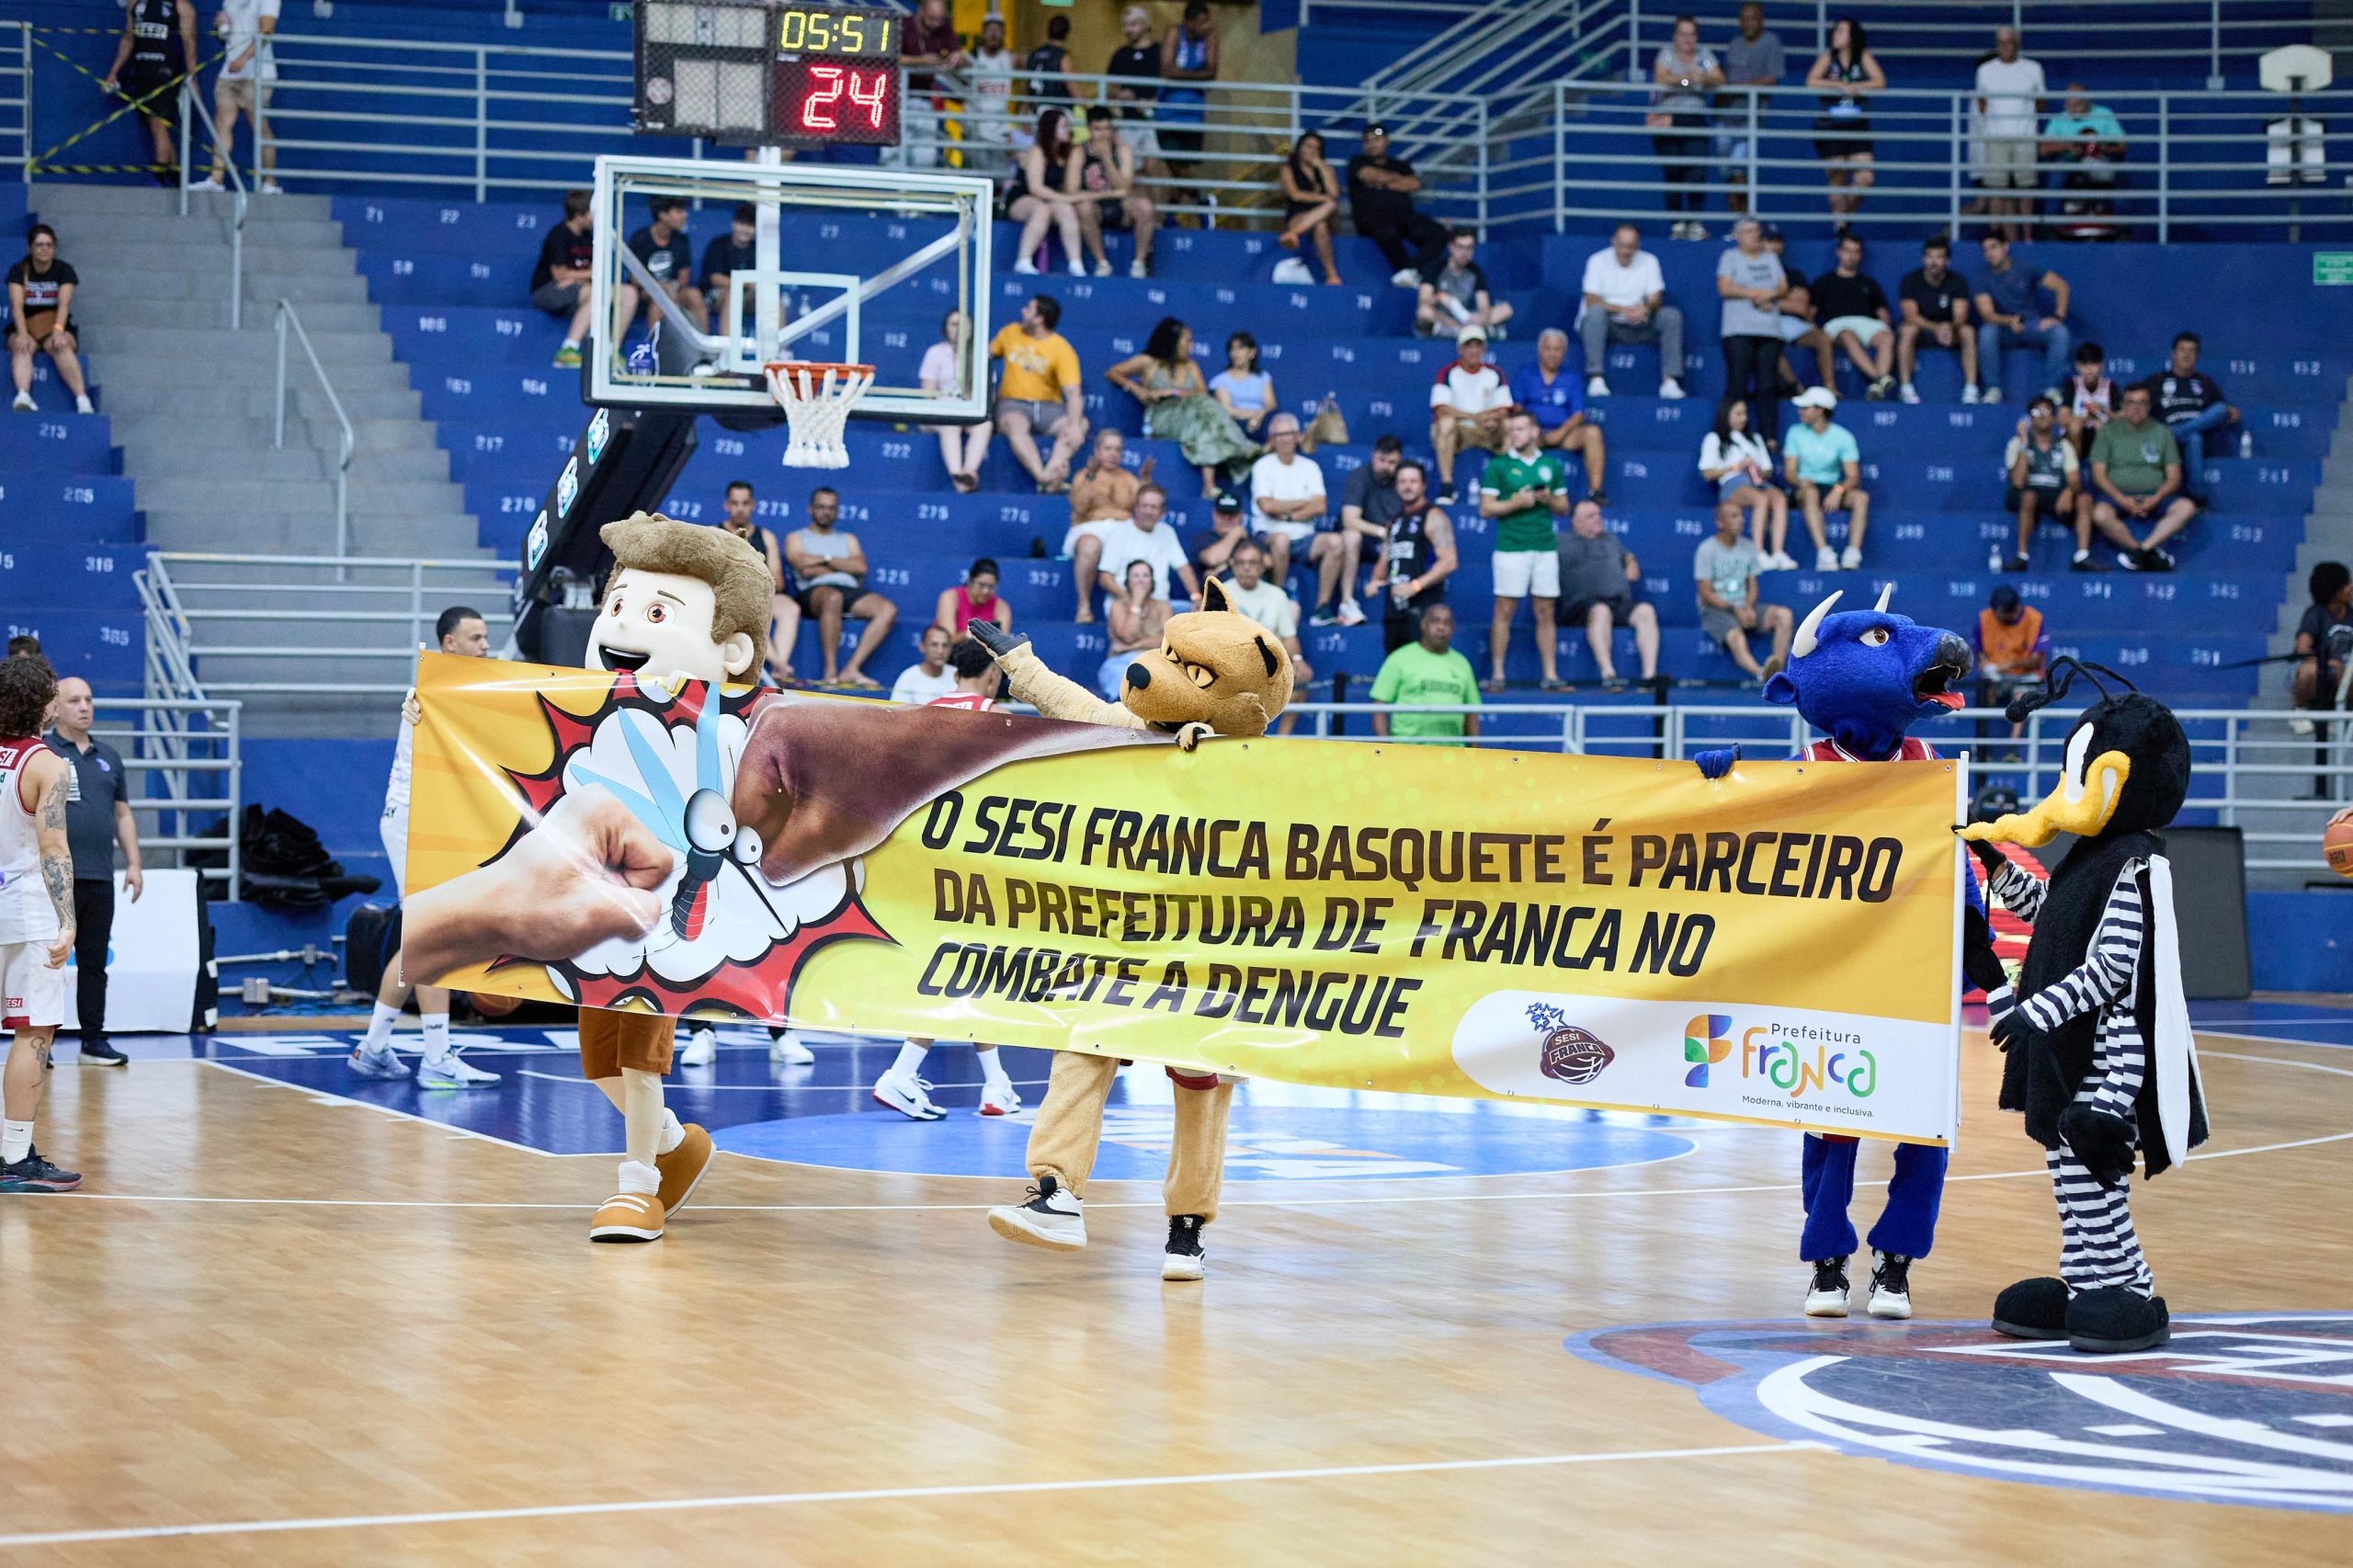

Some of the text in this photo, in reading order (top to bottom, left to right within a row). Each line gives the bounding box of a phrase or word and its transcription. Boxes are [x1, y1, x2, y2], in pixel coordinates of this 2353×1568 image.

[781, 11, 890, 52] 05:51
[802, 66, 887, 128] 24
[366, 206, 383, 223] 21
[441, 209, 460, 223] 22
[475, 435, 504, 451] 217
[501, 496, 536, 512] 270
[669, 500, 701, 517] 272
[757, 500, 790, 517] 273
[836, 504, 869, 520] 274
[85, 556, 113, 573] 316
[876, 568, 909, 585] 325
[1029, 571, 1061, 587] 327
[921, 790, 1903, 903] O SESI FRANCA BASQUETE É PARCEIRO
[934, 868, 1715, 978] DA PREFEITURA DE FRANCA NO
[916, 941, 1424, 1039] COMBATE A DENGUE
[1554, 1033, 1580, 1045] SESI
[1771, 1023, 1861, 1044] Prefeitura
[1551, 1043, 1601, 1063] FRANCA
[1742, 1096, 1784, 1108] Moderna,
[1786, 1100, 1824, 1112] vibrante
[1834, 1105, 1875, 1119] inclusiva.
